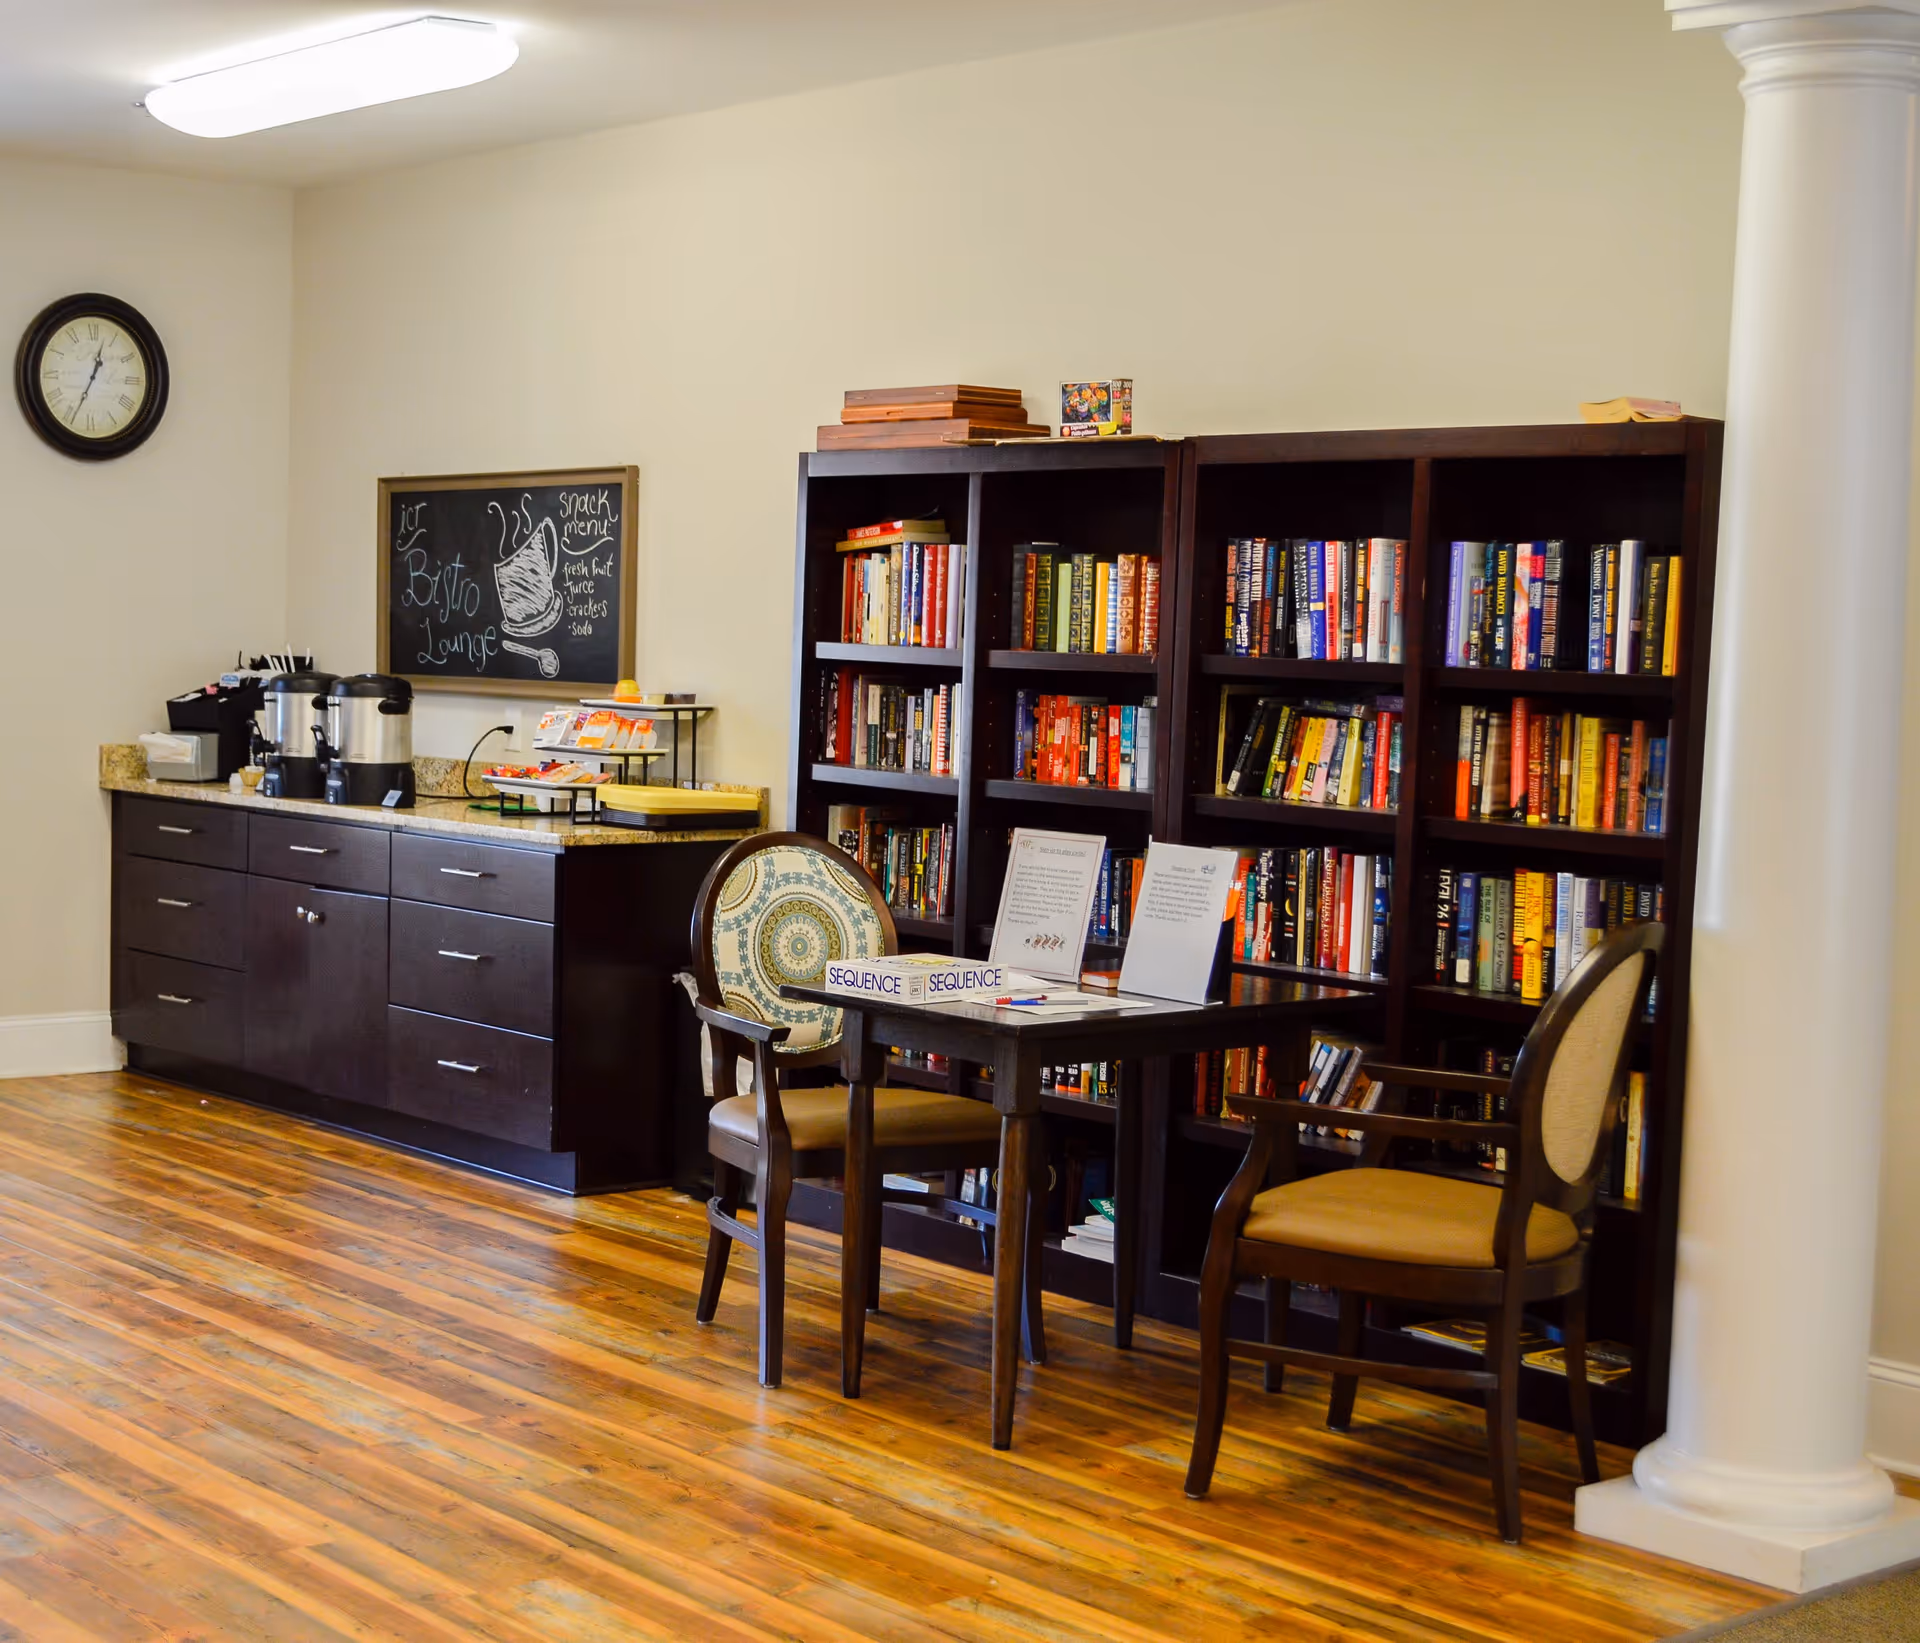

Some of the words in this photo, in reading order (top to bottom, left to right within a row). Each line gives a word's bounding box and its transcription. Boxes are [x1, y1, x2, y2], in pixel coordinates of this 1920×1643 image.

[559, 488, 618, 522] snack
[564, 560, 590, 587] fresh
[592, 553, 614, 578] fruit
[1299, 546, 1308, 598] HAMPTON
[1498, 550, 1507, 575] DAVID
[1592, 548, 1604, 590] VANISHING
[401, 548, 480, 624] Bistro
[1496, 576, 1506, 615] BALDACCI
[1544, 584, 1558, 596] THE
[1592, 595, 1602, 619] POINT
[572, 620, 593, 636] soda
[1240, 613, 1249, 647] Southern
[1495, 627, 1504, 650] ESCAPE
[417, 616, 498, 673] Lounge
[1540, 634, 1555, 656] PROOF
[1274, 733, 1284, 755] CUSSLER
[1474, 742, 1482, 752] THE
[1110, 752, 1118, 774] Death
[1472, 754, 1480, 766] OLD
[1472, 766, 1480, 786] BREED
[1436, 904, 1450, 919] 26
[1623, 886, 1636, 914] DAVID
[1640, 891, 1652, 917] DAVID
[829, 966, 902, 995] SEQUENCE
[928, 968, 1002, 993] SEQUENCE
